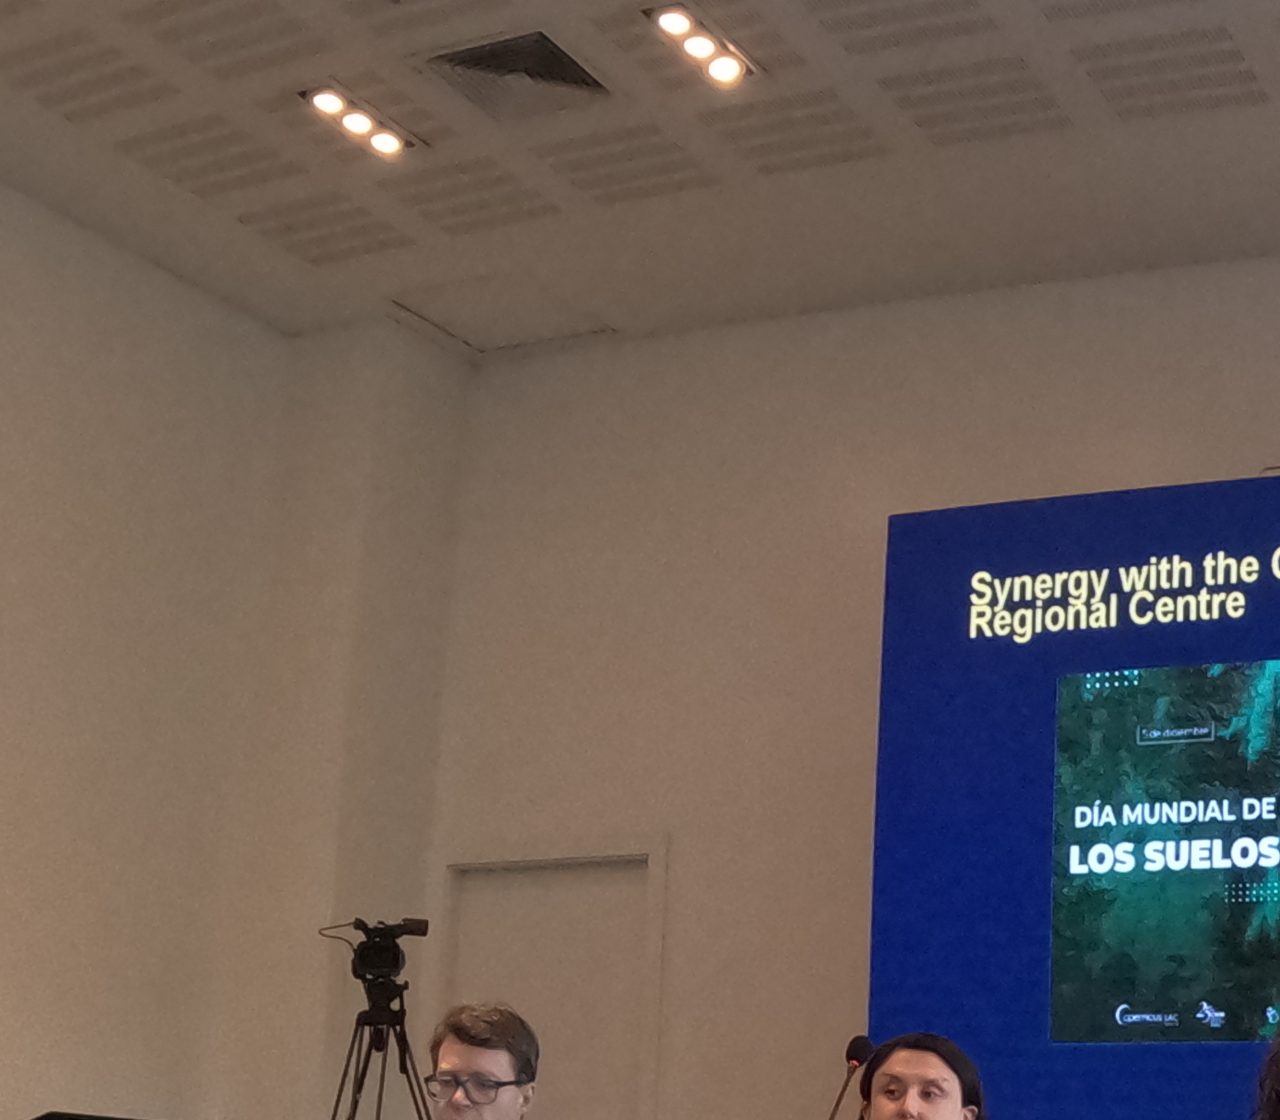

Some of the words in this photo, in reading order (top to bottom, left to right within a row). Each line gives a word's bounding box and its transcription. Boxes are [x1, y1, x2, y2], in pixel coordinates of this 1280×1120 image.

[969, 568, 1110, 611] Synergy
[1118, 554, 1193, 593] with
[1203, 551, 1260, 585] the
[968, 592, 1118, 644] Regional
[1128, 587, 1246, 626] Centre
[1074, 800, 1117, 828] DÍA
[1122, 799, 1237, 826] MUNDIAL
[1242, 797, 1277, 820] DE
[1069, 842, 1136, 875] LOS
